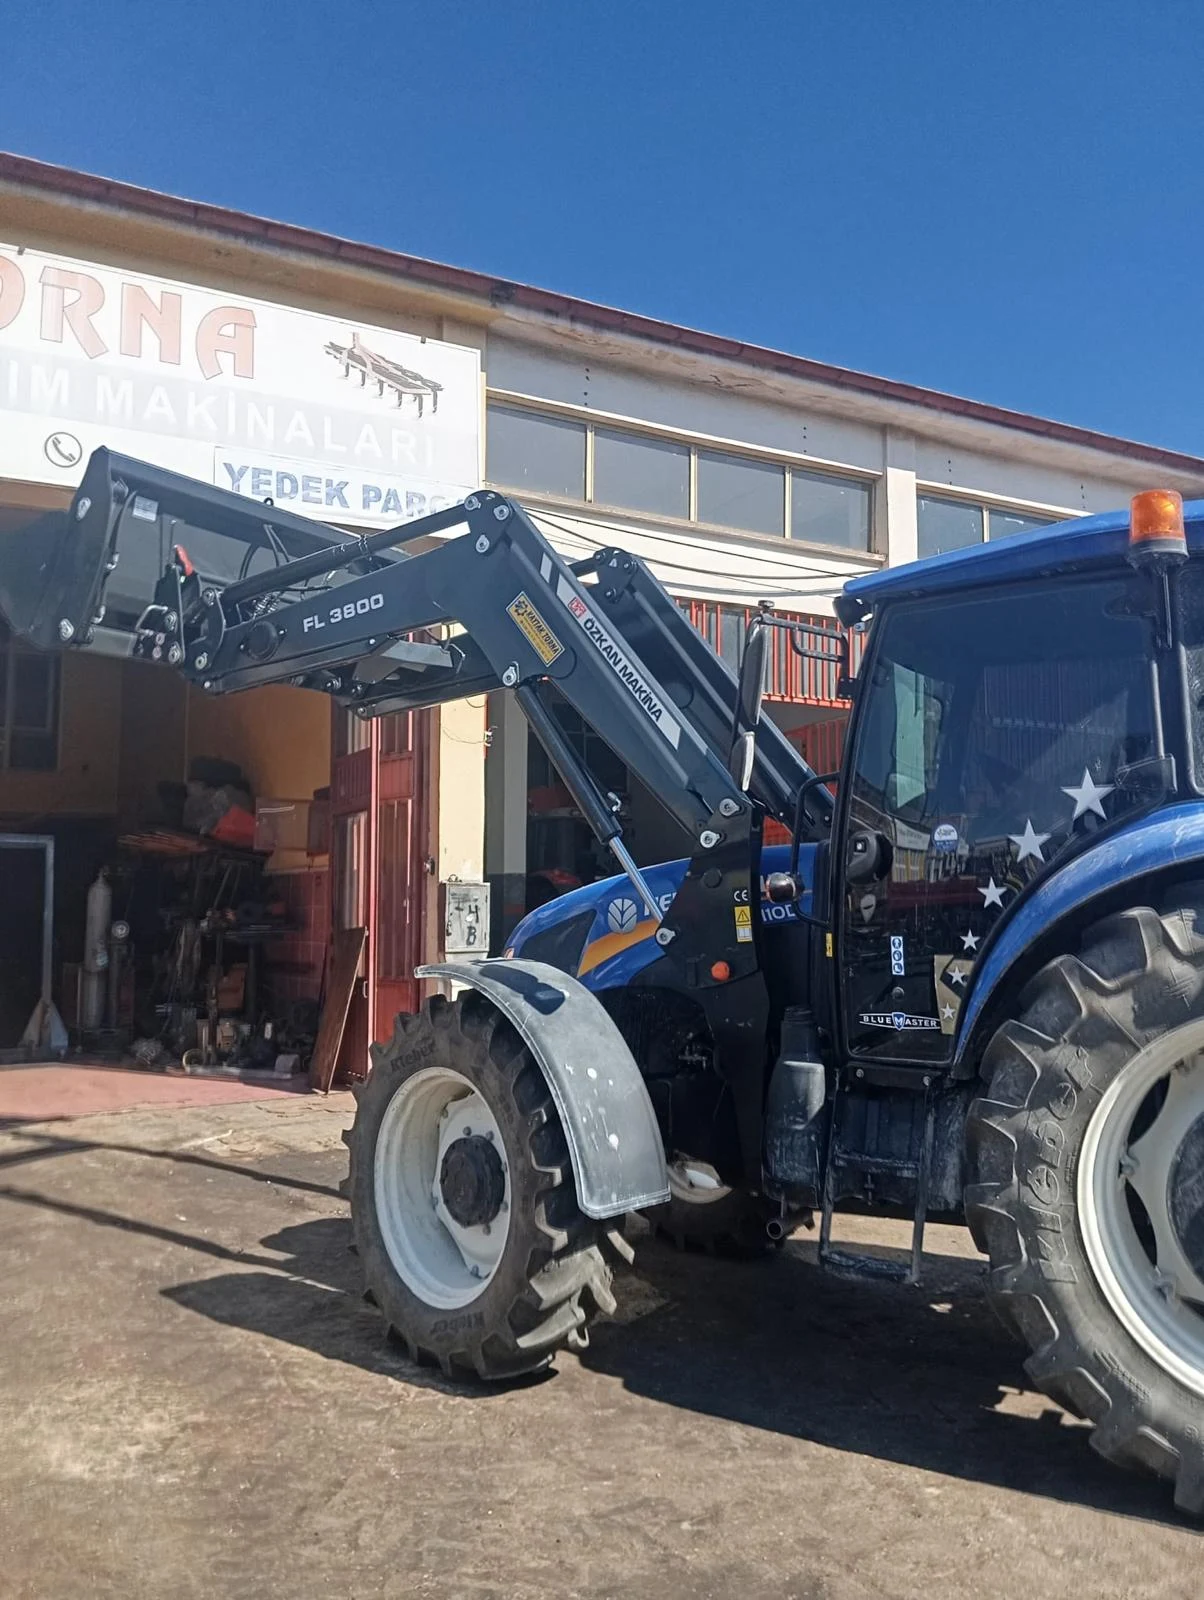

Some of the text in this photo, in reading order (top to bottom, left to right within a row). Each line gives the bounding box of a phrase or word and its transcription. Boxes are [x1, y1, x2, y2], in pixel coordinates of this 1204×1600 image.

[96, 375, 434, 465] MAKİNALARI
[223, 462, 464, 518] YEDEK PAR
[303, 593, 384, 633] FL 3800
[583, 617, 663, 722] ÖZKAN MAKİNA
